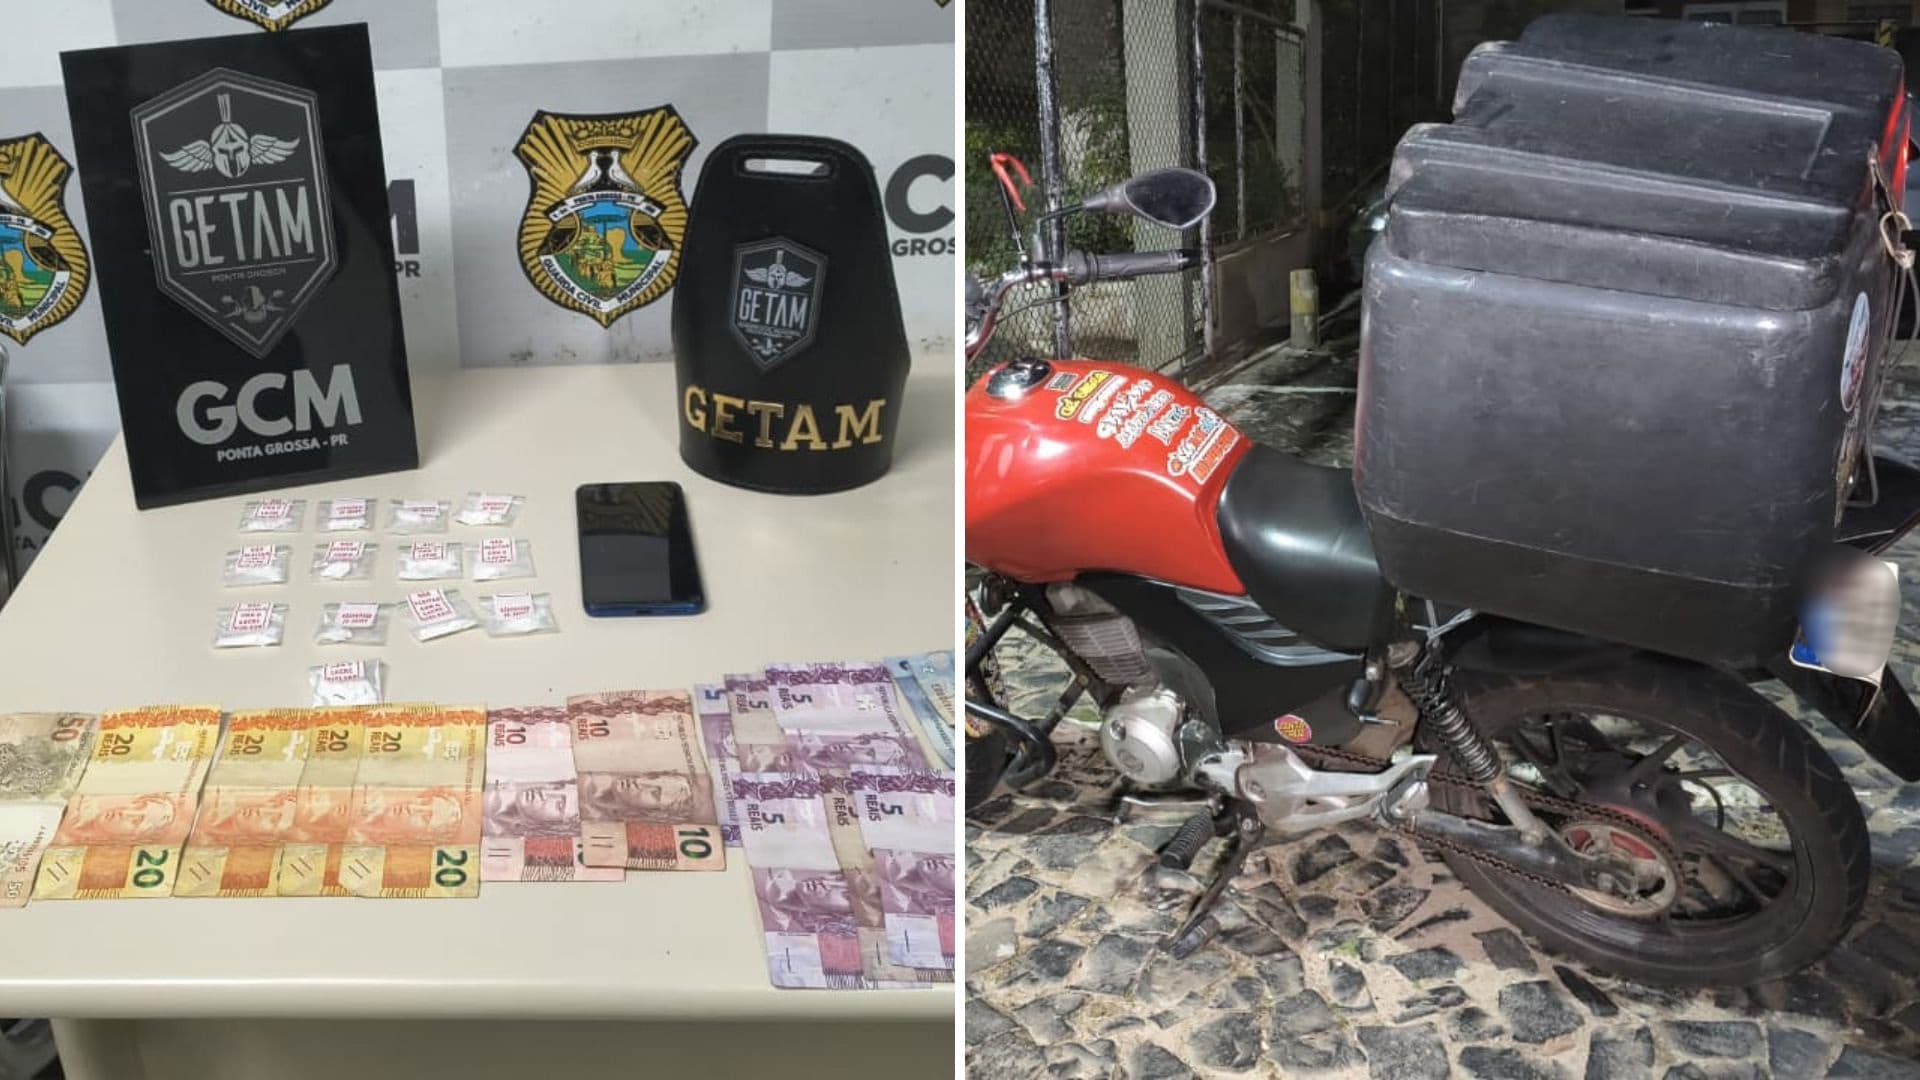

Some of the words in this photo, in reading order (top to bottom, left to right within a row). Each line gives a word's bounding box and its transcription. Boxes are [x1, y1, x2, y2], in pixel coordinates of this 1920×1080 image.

[169, 186, 315, 267] GETAM
[543, 258, 576, 296] GUARDA
[576, 291, 603, 310] CIVIL
[616, 259, 665, 304] MUNICIPAL
[27, 280, 67, 322] MUNICIPAL
[738, 288, 809, 331] GETAM
[176, 363, 363, 445] GCM
[684, 384, 887, 451] GETAM
[217, 446, 264, 463] PONTA
[265, 438, 321, 456] GROSSA
[330, 434, 349, 447] PR
[748, 700, 769, 709] 5
[791, 694, 813, 703] 5
[50, 716, 86, 742] 50
[328, 729, 349, 752] 20
[381, 731, 402, 753] 20
[505, 726, 527, 745] 10
[589, 719, 610, 739] 10
[111, 733, 134, 756] 20
[242, 734, 265, 755] 20
[747, 803, 763, 832] REAIS
[761, 811, 785, 824] 5
[833, 796, 850, 827] REAIS
[864, 793, 882, 822] REAIS
[880, 802, 904, 816] 5
[678, 827, 713, 860] 10
[132, 848, 170, 889] 20
[434, 849, 468, 888] 20
